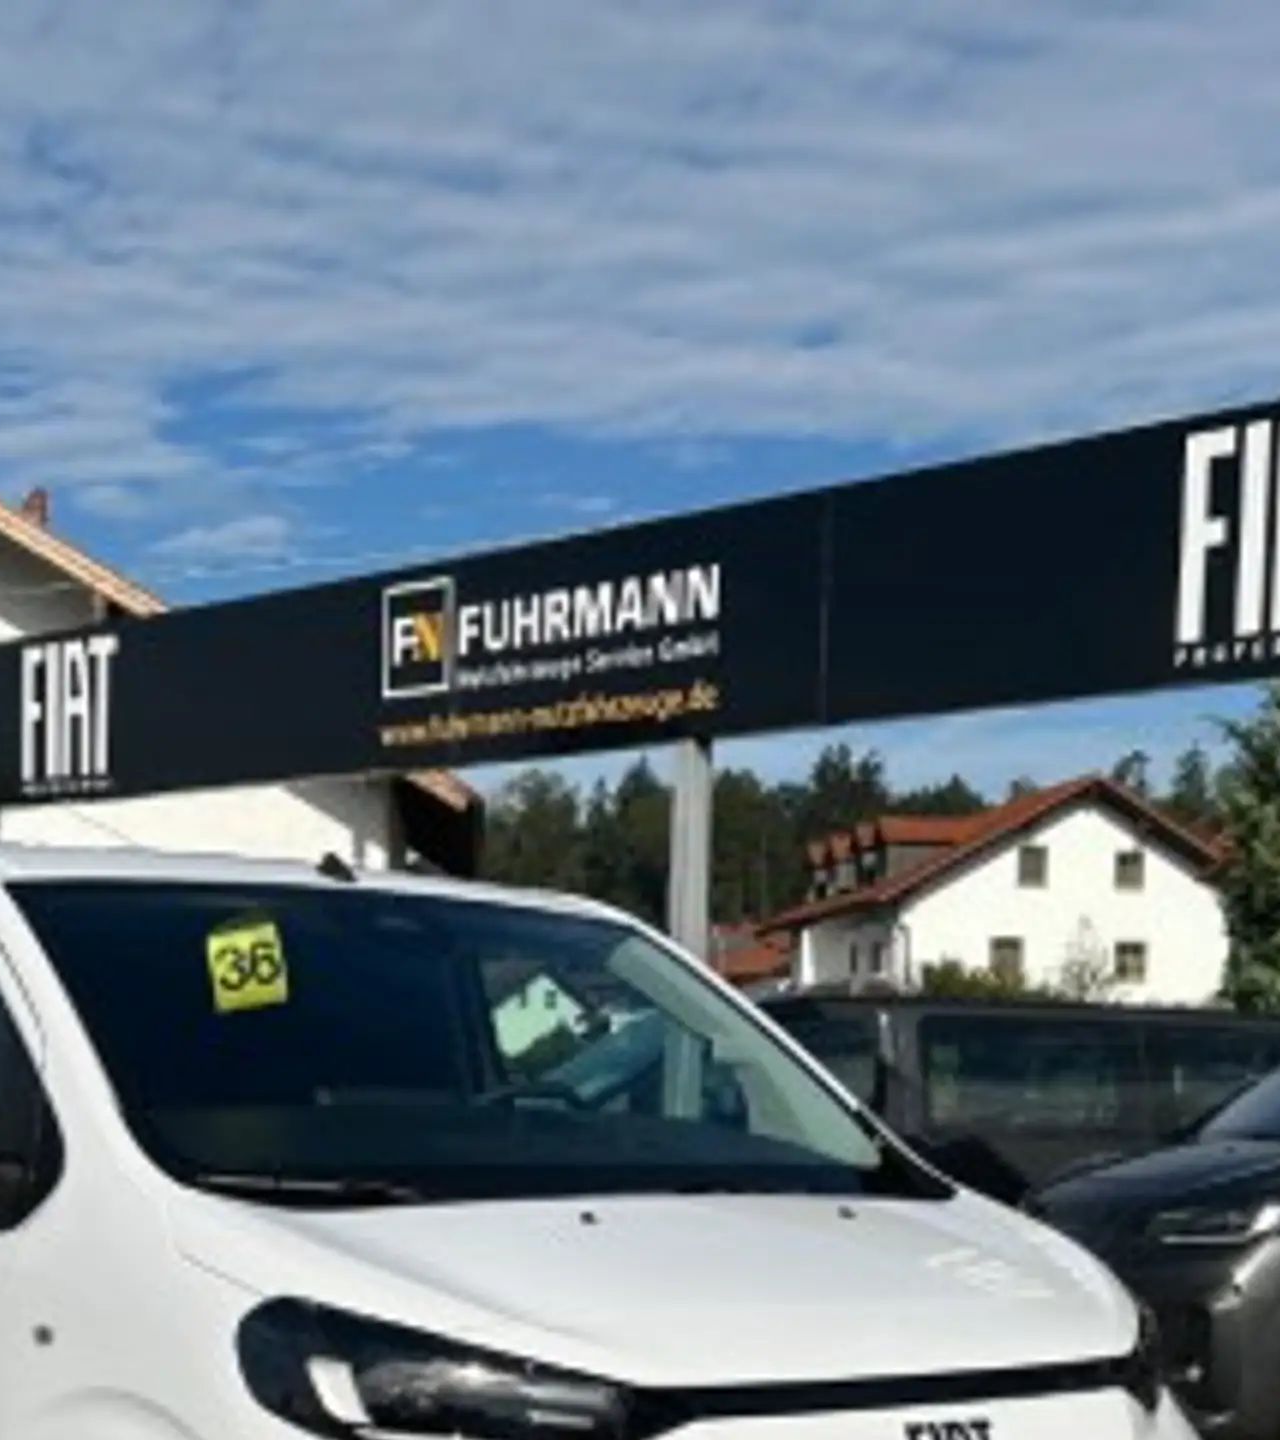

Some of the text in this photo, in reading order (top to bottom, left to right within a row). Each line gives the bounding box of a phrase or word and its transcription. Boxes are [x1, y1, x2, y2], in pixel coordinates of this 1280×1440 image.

[458, 563, 720, 655] FUHRMANN
[22, 635, 118, 781] FIAT
[215, 942, 280, 991] 36
